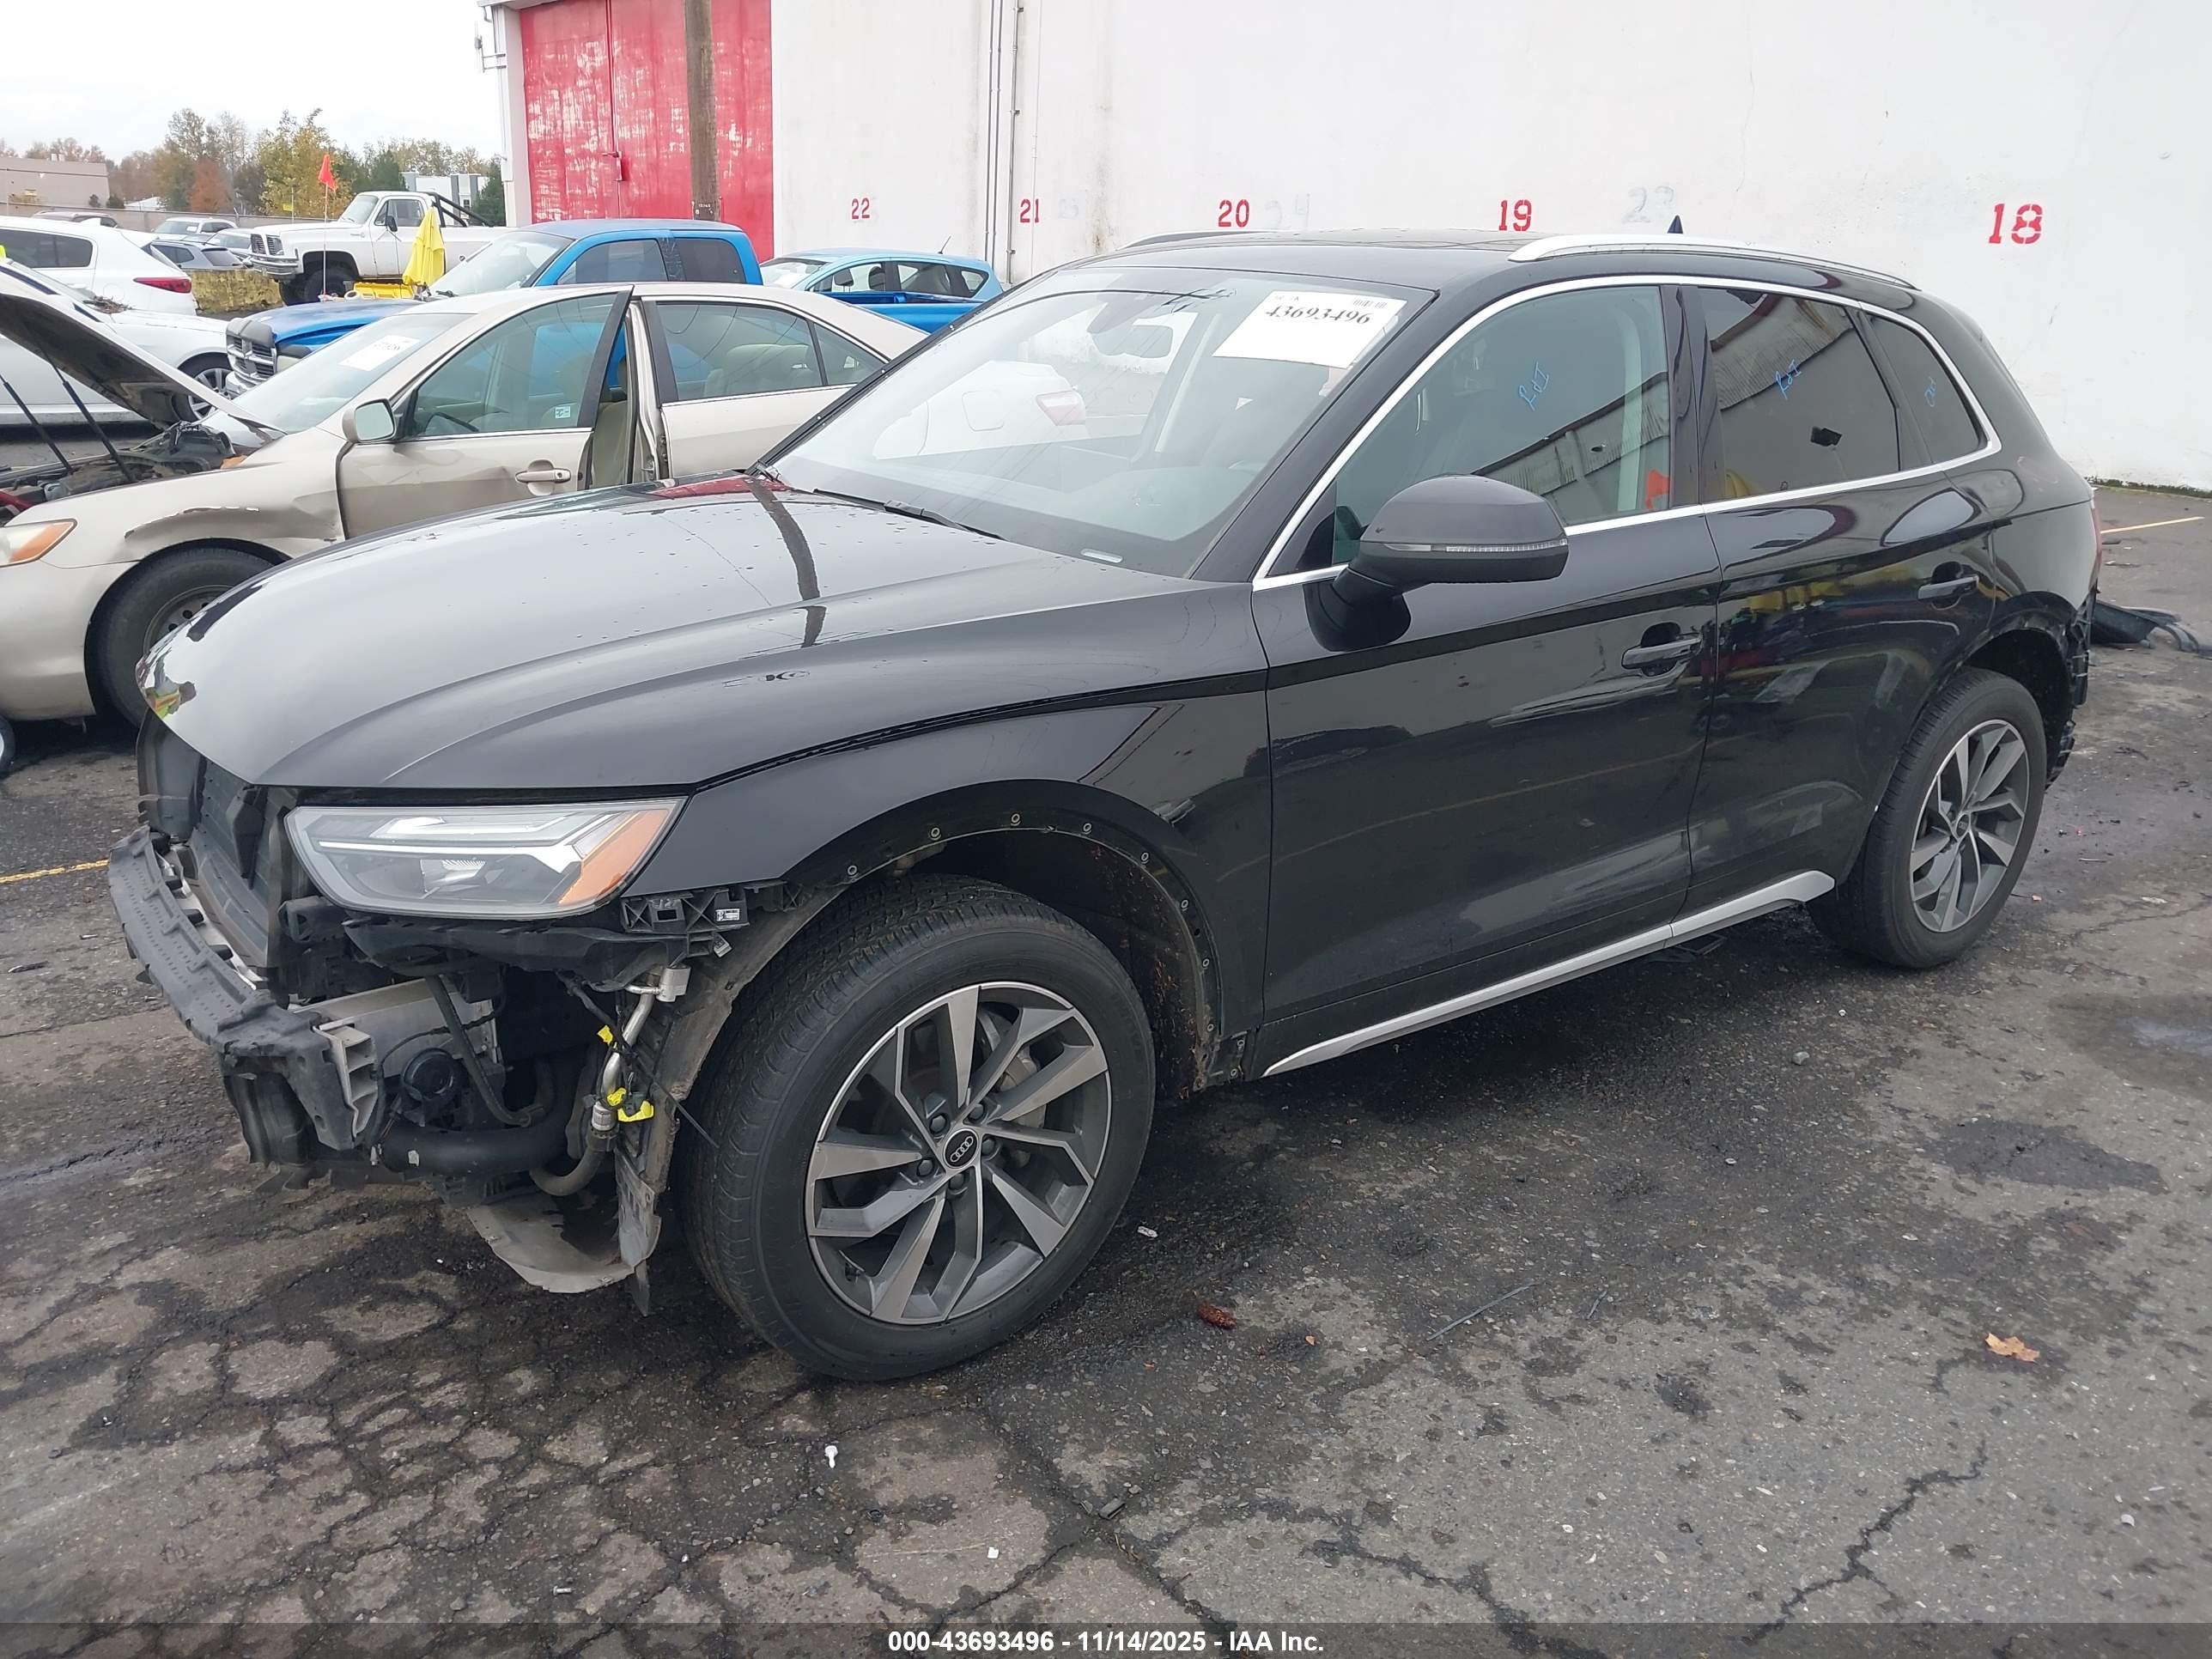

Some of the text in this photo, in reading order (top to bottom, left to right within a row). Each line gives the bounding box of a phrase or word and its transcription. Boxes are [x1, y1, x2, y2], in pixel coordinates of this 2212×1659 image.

[852, 198, 870, 220] 22
[1019, 198, 1040, 224] 21
[1218, 198, 1250, 228] 20
[1498, 198, 1533, 232] 19
[1989, 203, 2044, 245] 18
[1266, 305, 1372, 325] 43693496
